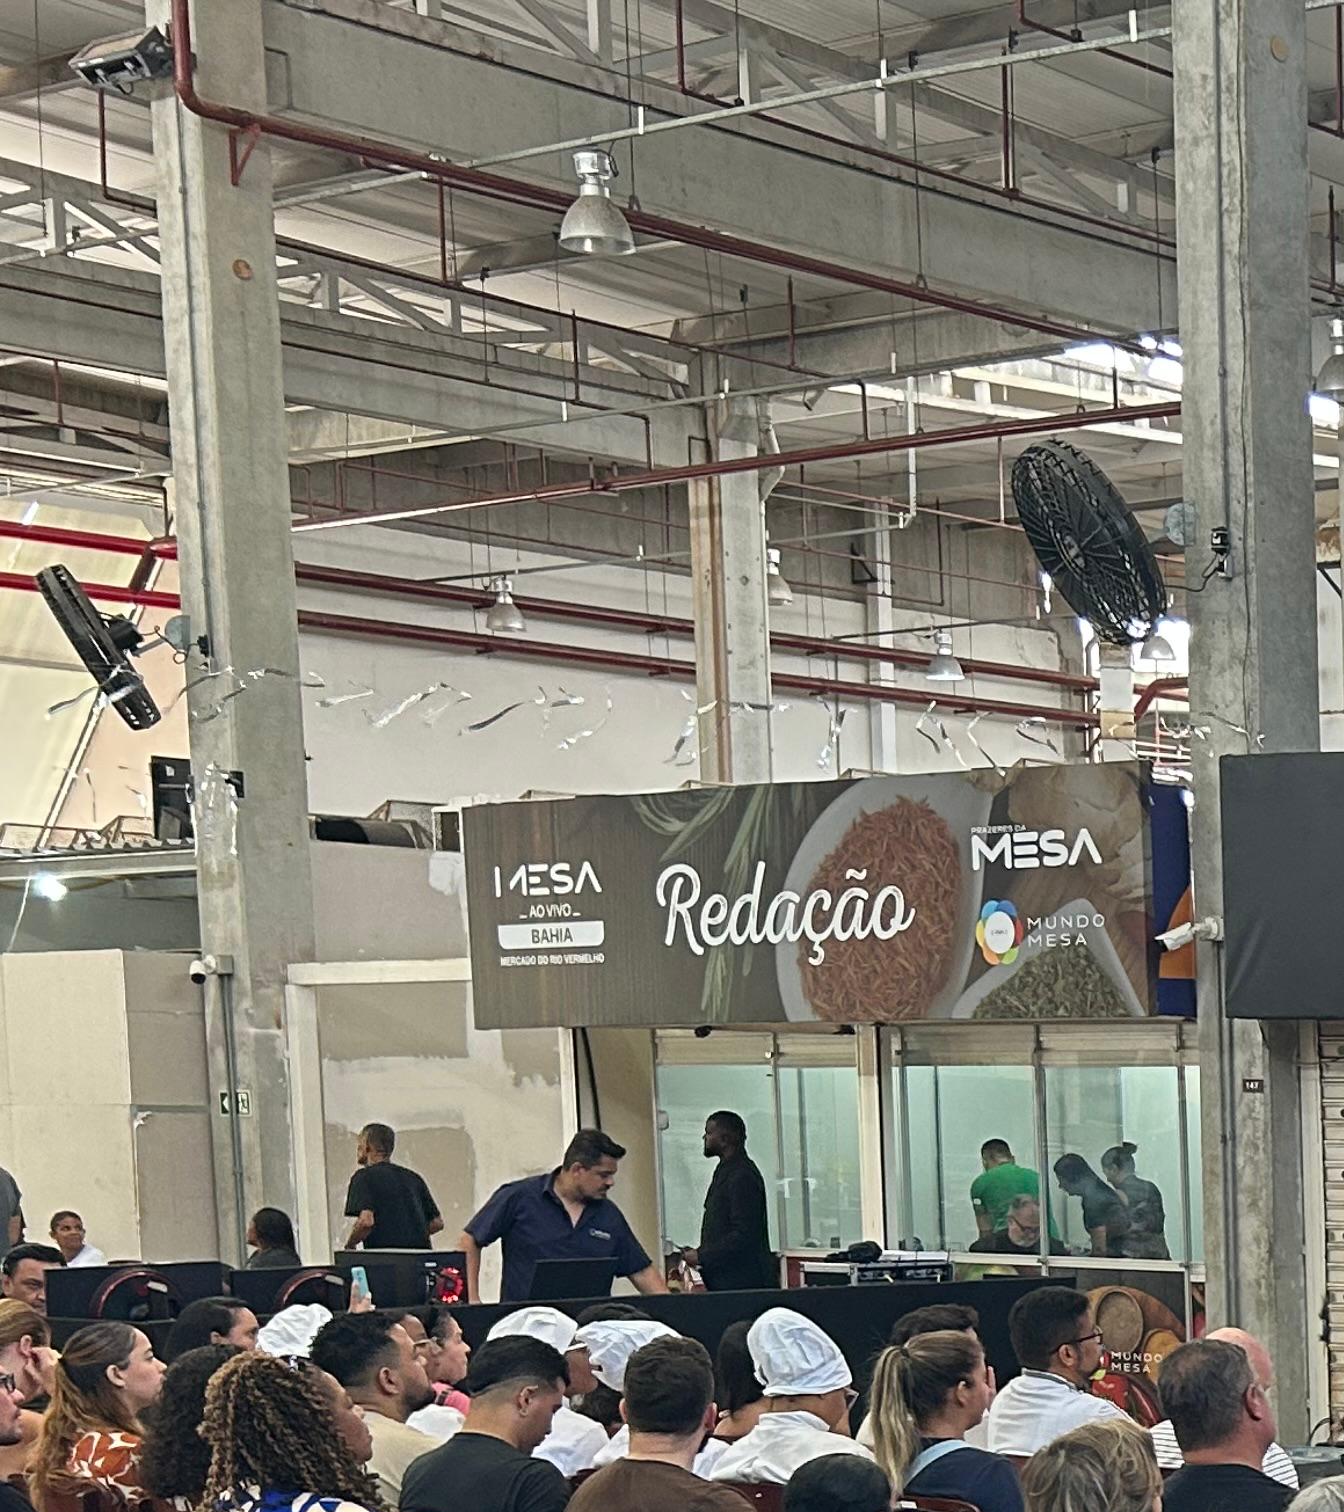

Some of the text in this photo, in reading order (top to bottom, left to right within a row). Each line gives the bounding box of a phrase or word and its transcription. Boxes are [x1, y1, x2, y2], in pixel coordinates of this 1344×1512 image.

[971, 828, 1103, 871] MESA
[494, 861, 603, 898] MESA
[529, 903, 572, 918] AO VIVO
[656, 860, 916, 966] Redação
[1026, 914, 1106, 930] MUNDO
[531, 927, 574, 945] BAHIA
[1027, 932, 1088, 948] MESA
[500, 954, 537, 967] MERCADO
[1110, 1351, 1163, 1363] MUNDO
[1111, 1362, 1151, 1374] MESA
